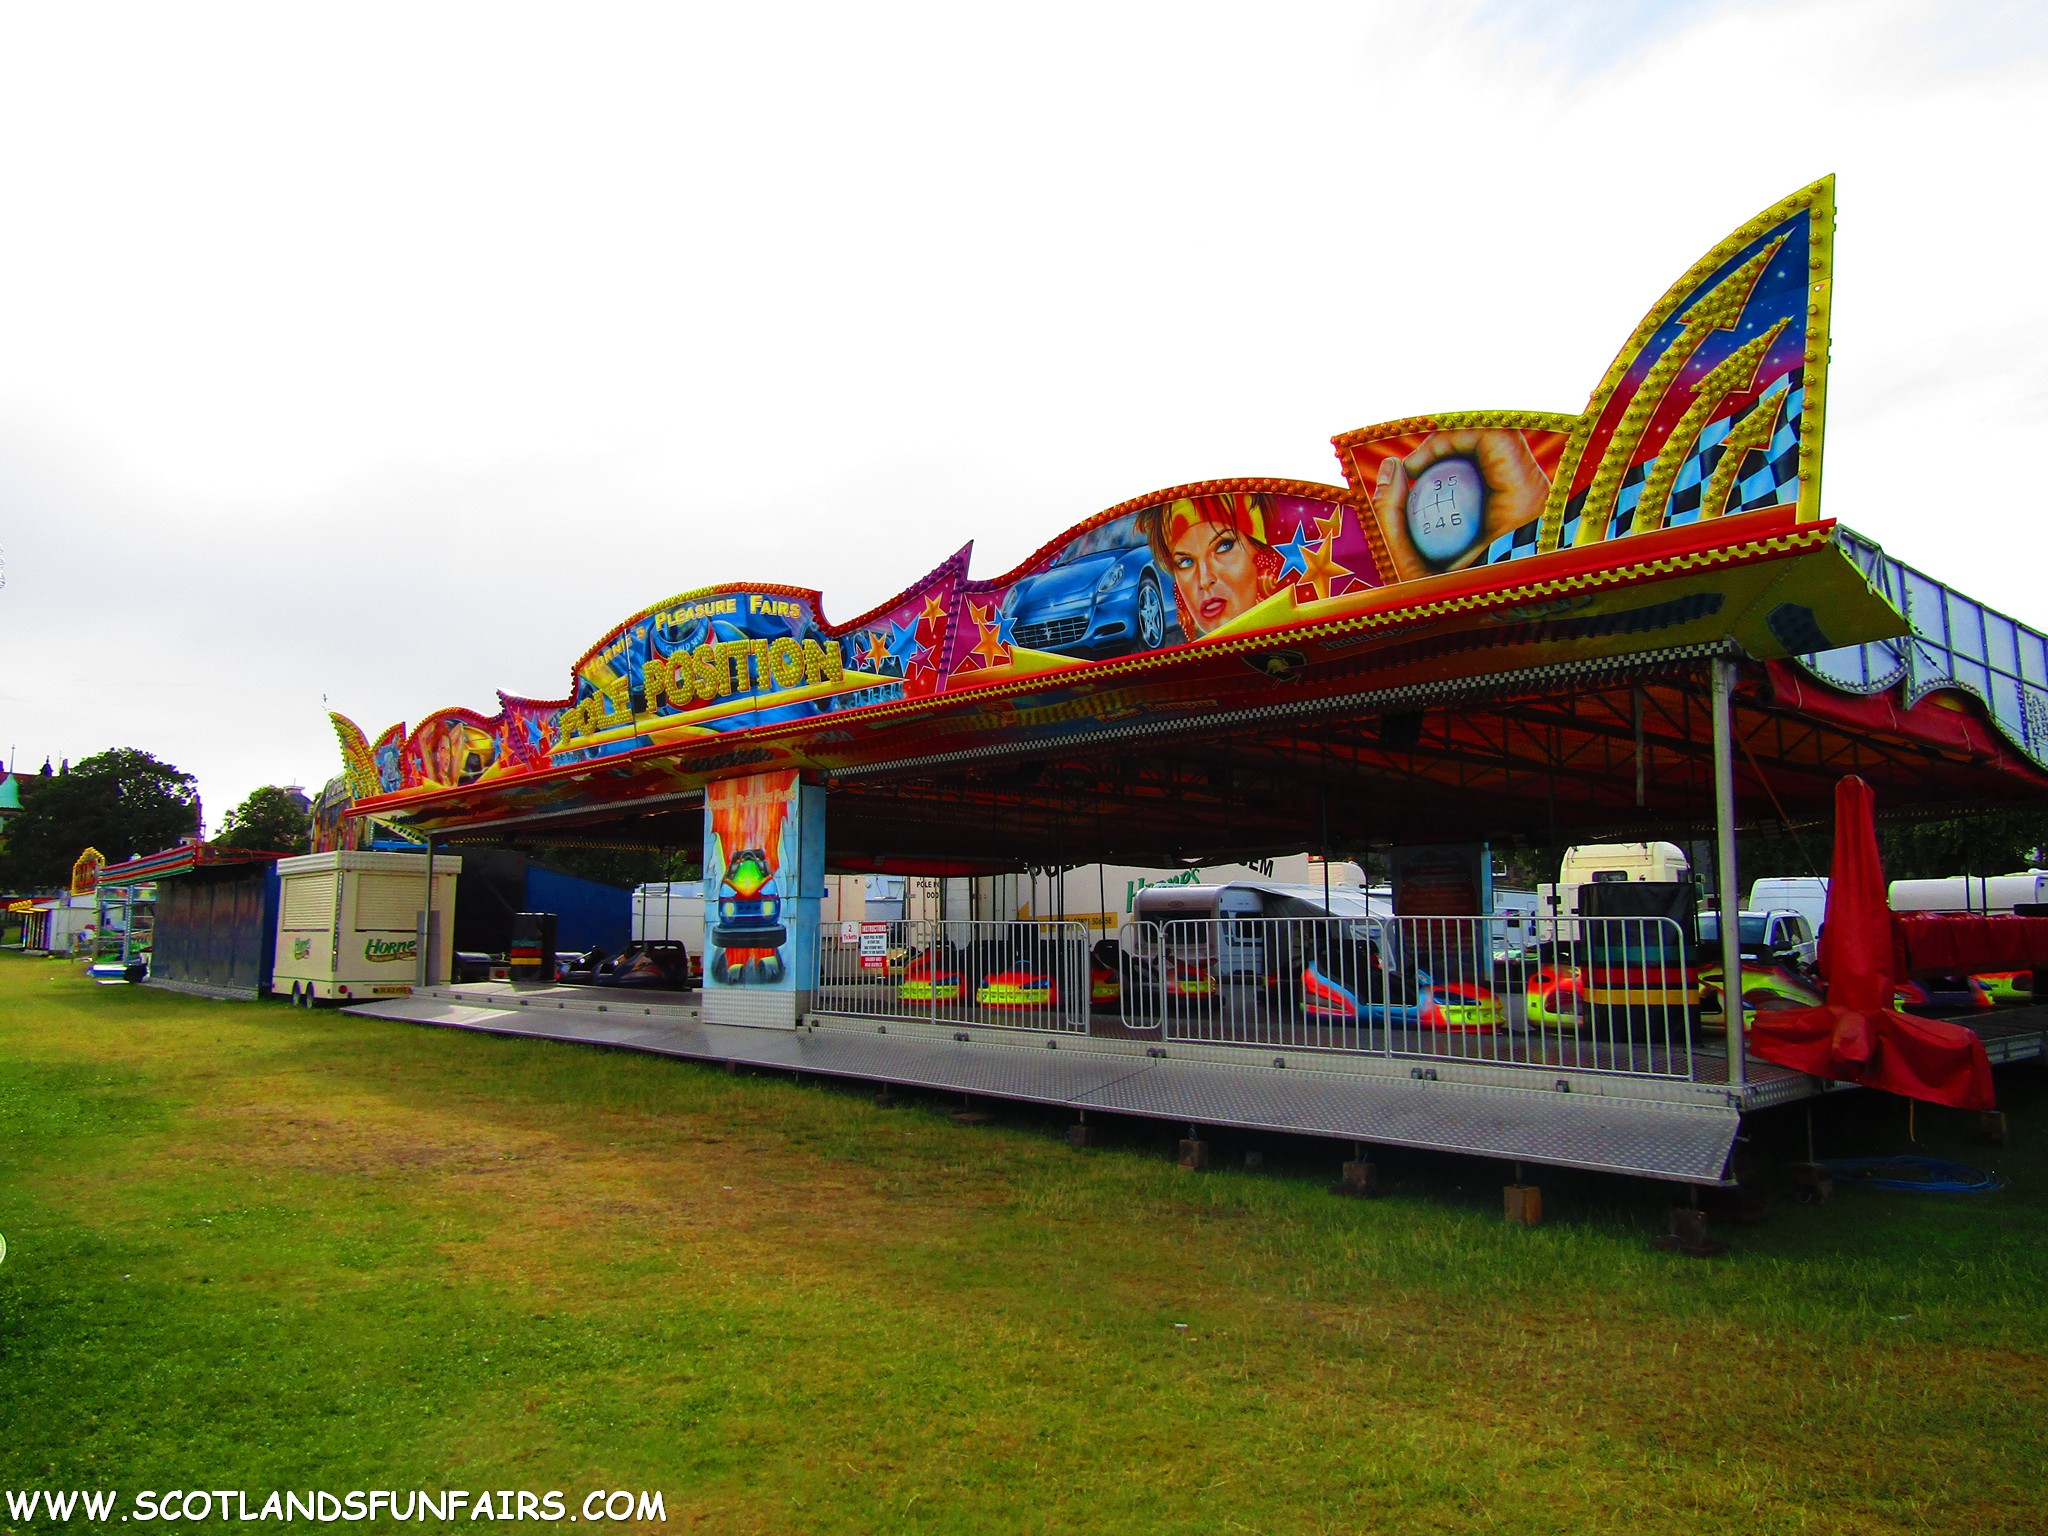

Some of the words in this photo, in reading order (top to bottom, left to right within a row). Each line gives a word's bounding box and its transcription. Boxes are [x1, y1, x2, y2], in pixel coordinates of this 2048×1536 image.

[1433, 480, 1442, 490] 3
[1448, 475, 1457, 486] 5
[1423, 522, 1431, 534] 2
[1436, 517, 1446, 528] 4
[1451, 513, 1462, 526] 6
[750, 595, 801, 619] FAIRS
[560, 674, 634, 744] POLE
[642, 636, 844, 714] POSITION
[848, 924, 853, 932] 2
